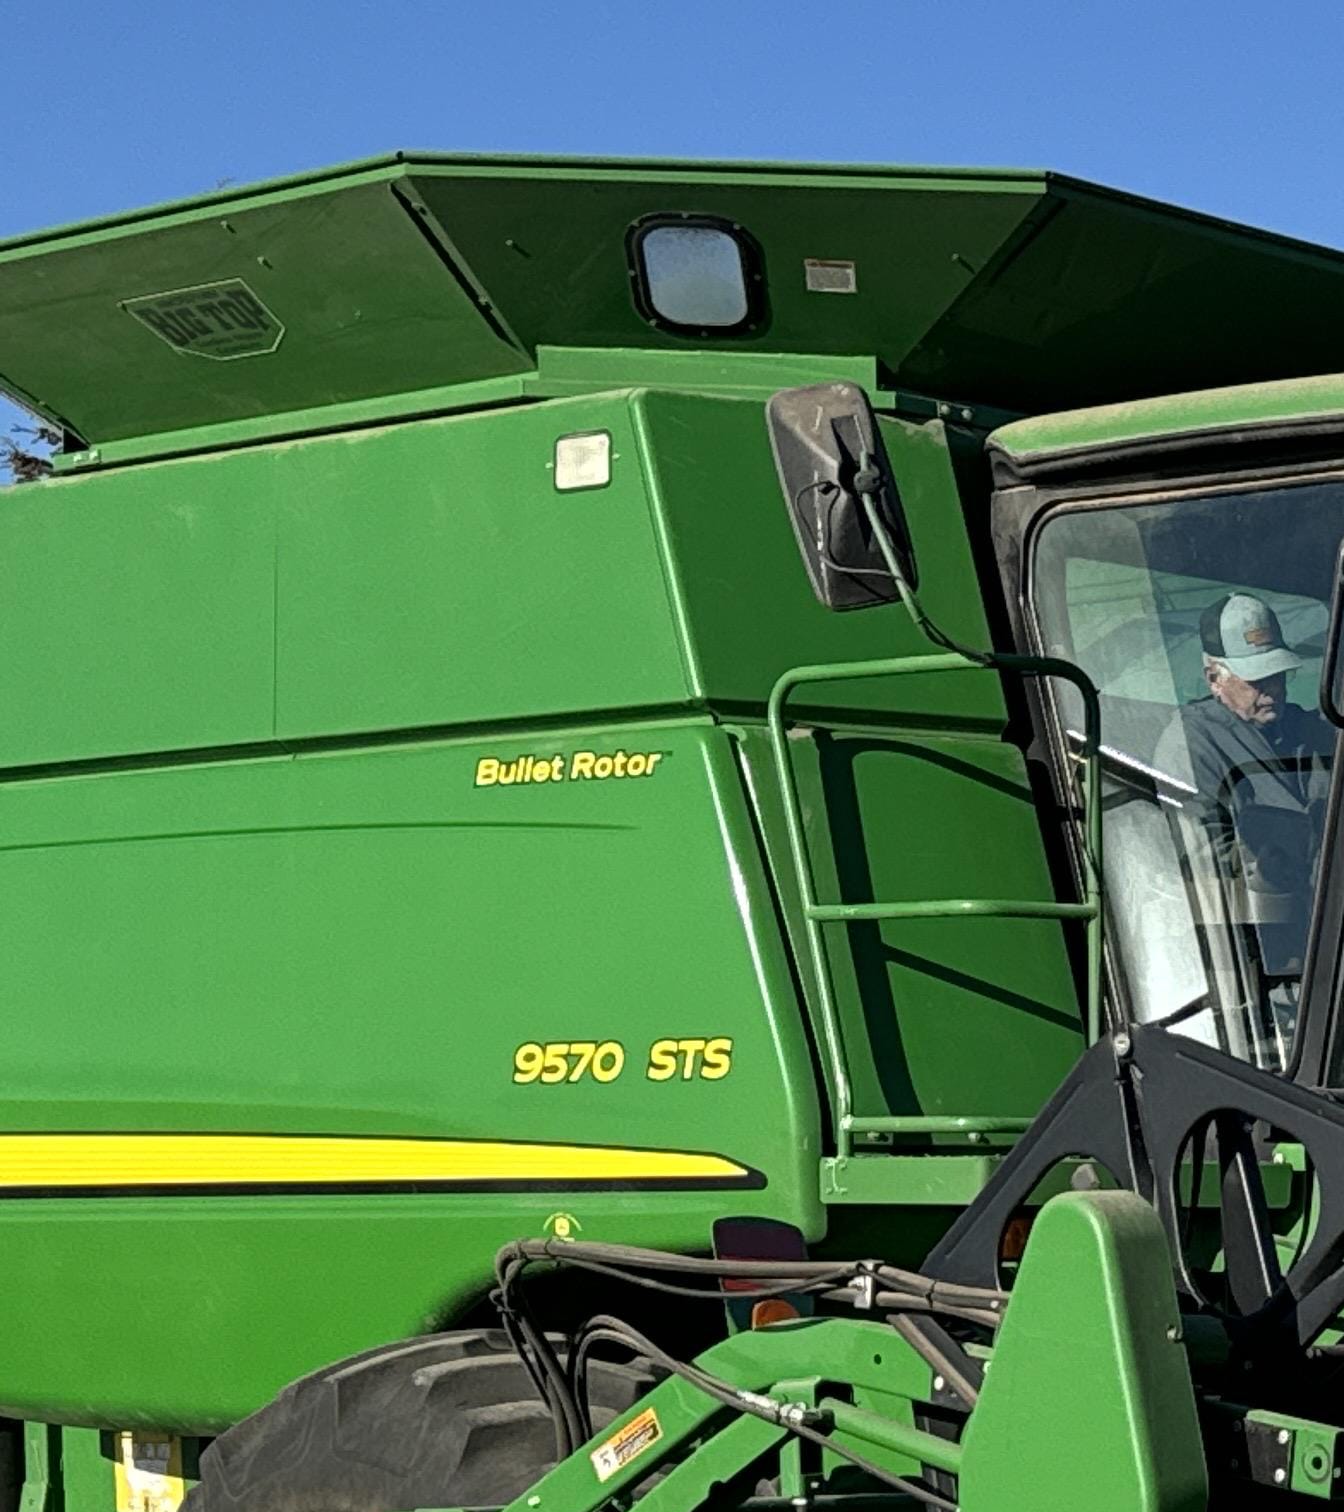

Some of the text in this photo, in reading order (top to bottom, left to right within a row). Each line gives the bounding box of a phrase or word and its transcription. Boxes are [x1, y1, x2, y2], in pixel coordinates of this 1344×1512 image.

[133, 307, 215, 347] BIG
[195, 289, 271, 332] TOP
[474, 749, 663, 788] Bullet Rotor
[513, 1037, 734, 1083] 9570 STS
